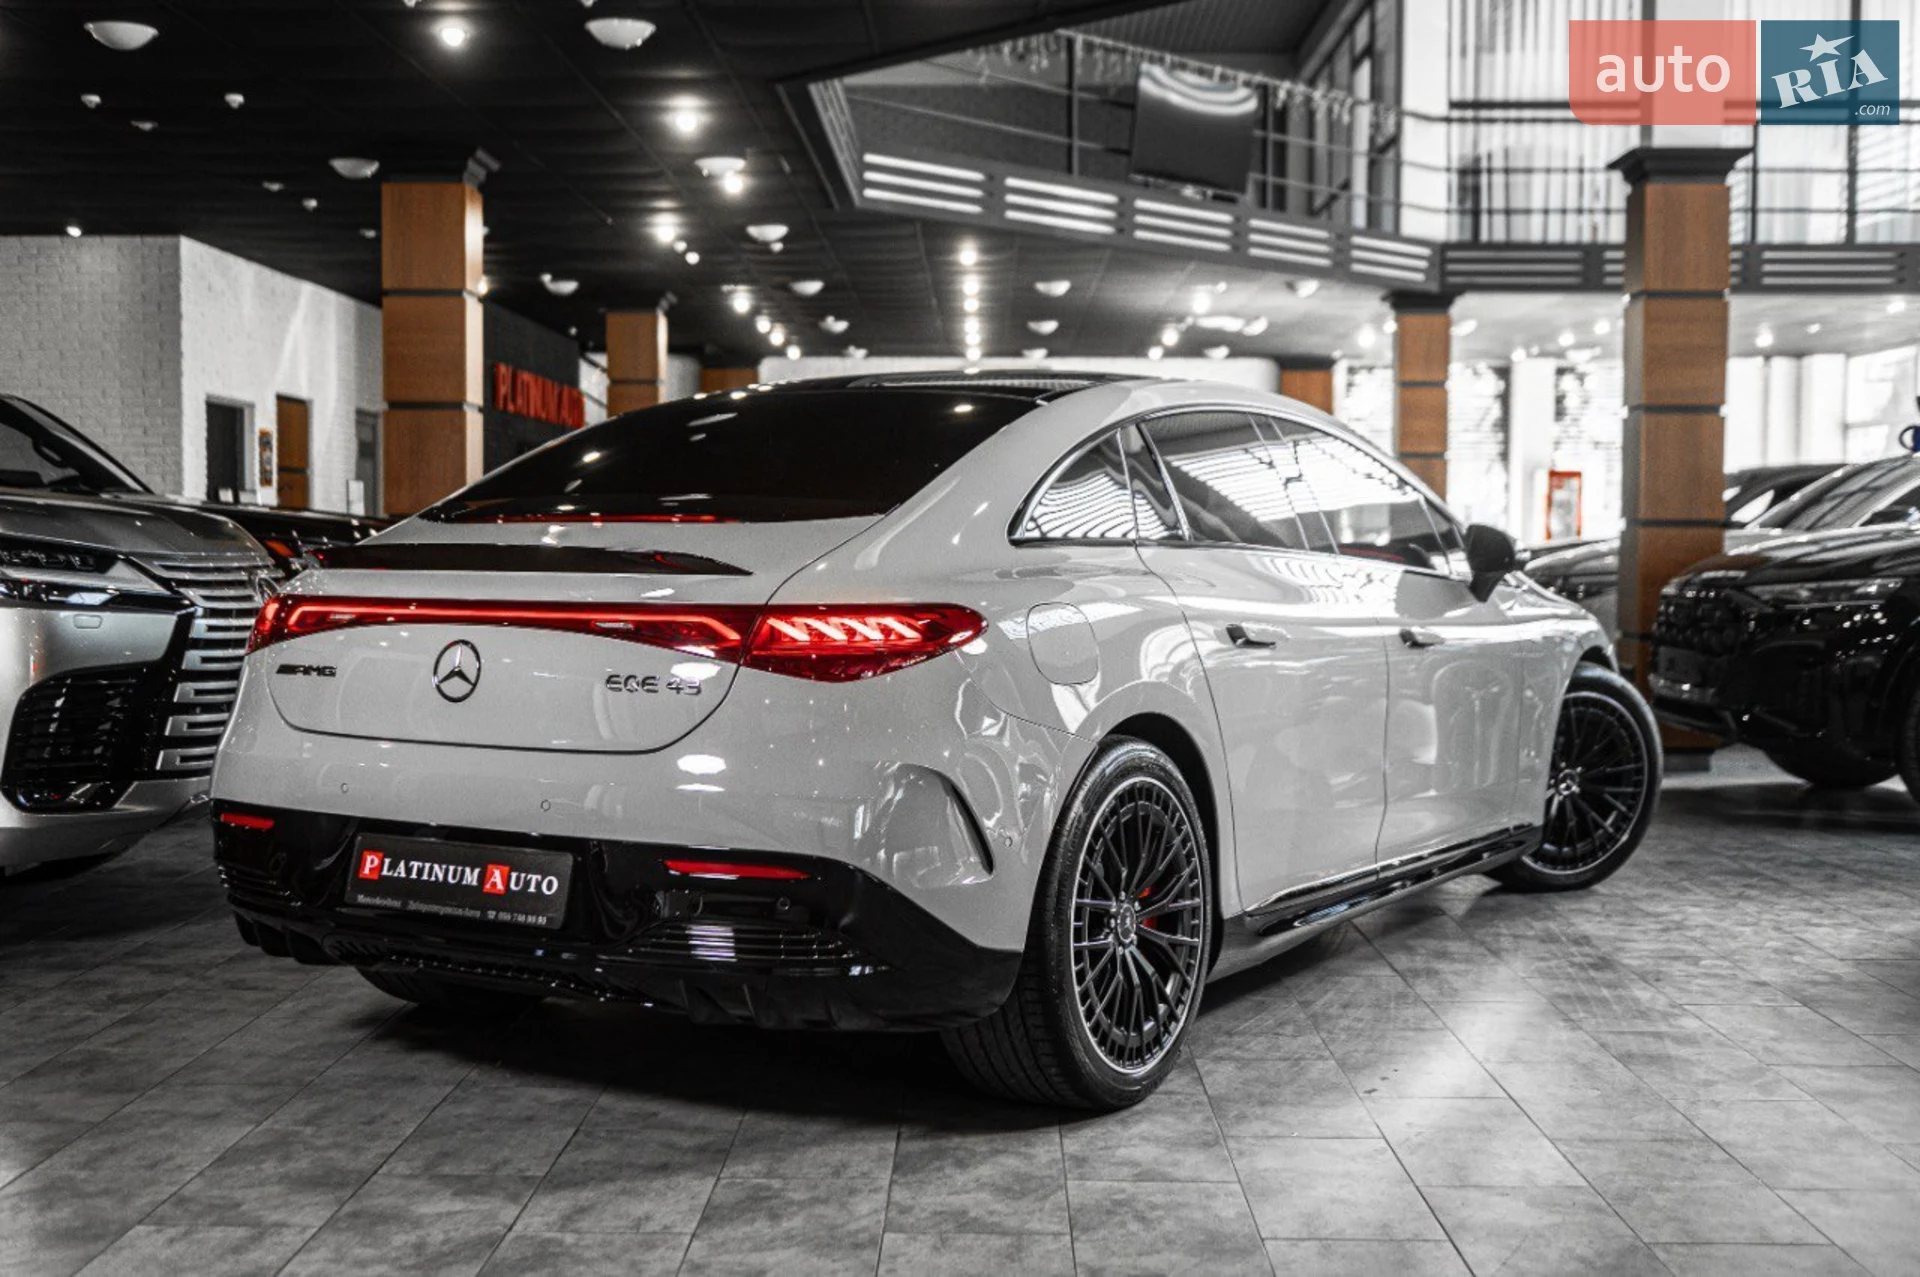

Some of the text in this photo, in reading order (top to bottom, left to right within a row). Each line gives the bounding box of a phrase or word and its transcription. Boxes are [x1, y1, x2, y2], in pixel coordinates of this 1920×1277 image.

[289, 664, 338, 677] AMG
[605, 674, 702, 695] EQE 43
[361, 853, 559, 895] PLATINUM AUTO
